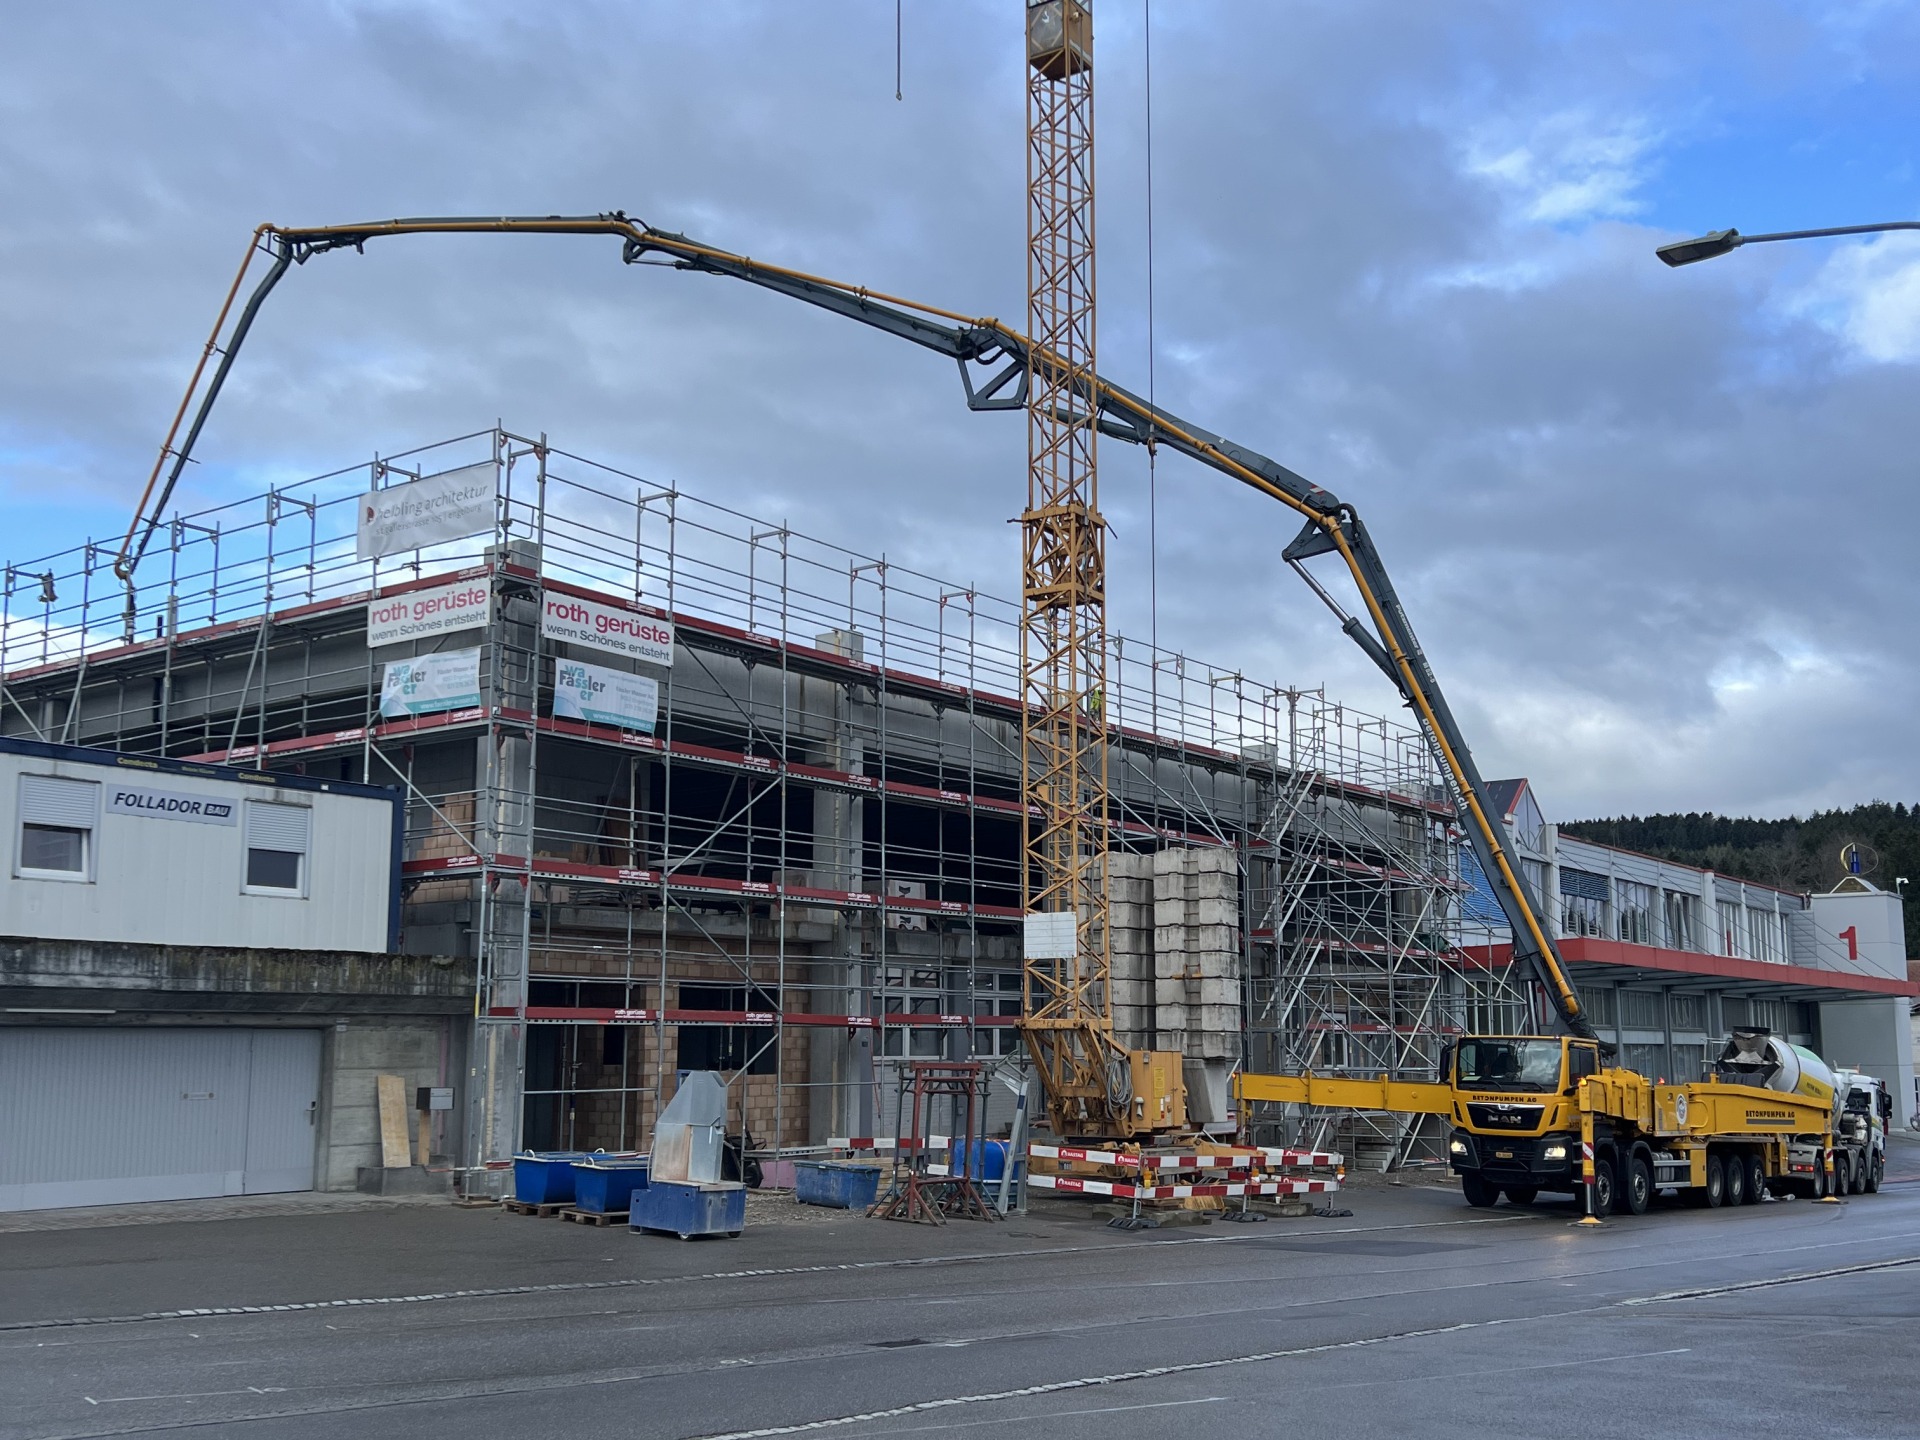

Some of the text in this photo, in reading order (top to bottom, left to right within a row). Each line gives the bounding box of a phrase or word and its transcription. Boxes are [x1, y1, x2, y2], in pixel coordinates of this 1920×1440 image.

[425, 485, 488, 511] architektur
[372, 588, 486, 625] roth gerüste
[371, 610, 486, 641] wenn Schönes entsteht
[547, 601, 670, 645] roth gerüste
[546, 624, 670, 661] wenn Schönes entsteht
[580, 690, 593, 701] er
[1422, 718, 1469, 811] betonpumpen.ch
[114, 792, 228, 816] FOLLADOR BAU
[1839, 926, 1857, 960] 1
[1472, 1095, 1524, 1103] BETONPUMPEN
[1487, 1115, 1521, 1124] MAN
[1746, 1110, 1786, 1118] BETONPUMPEN
